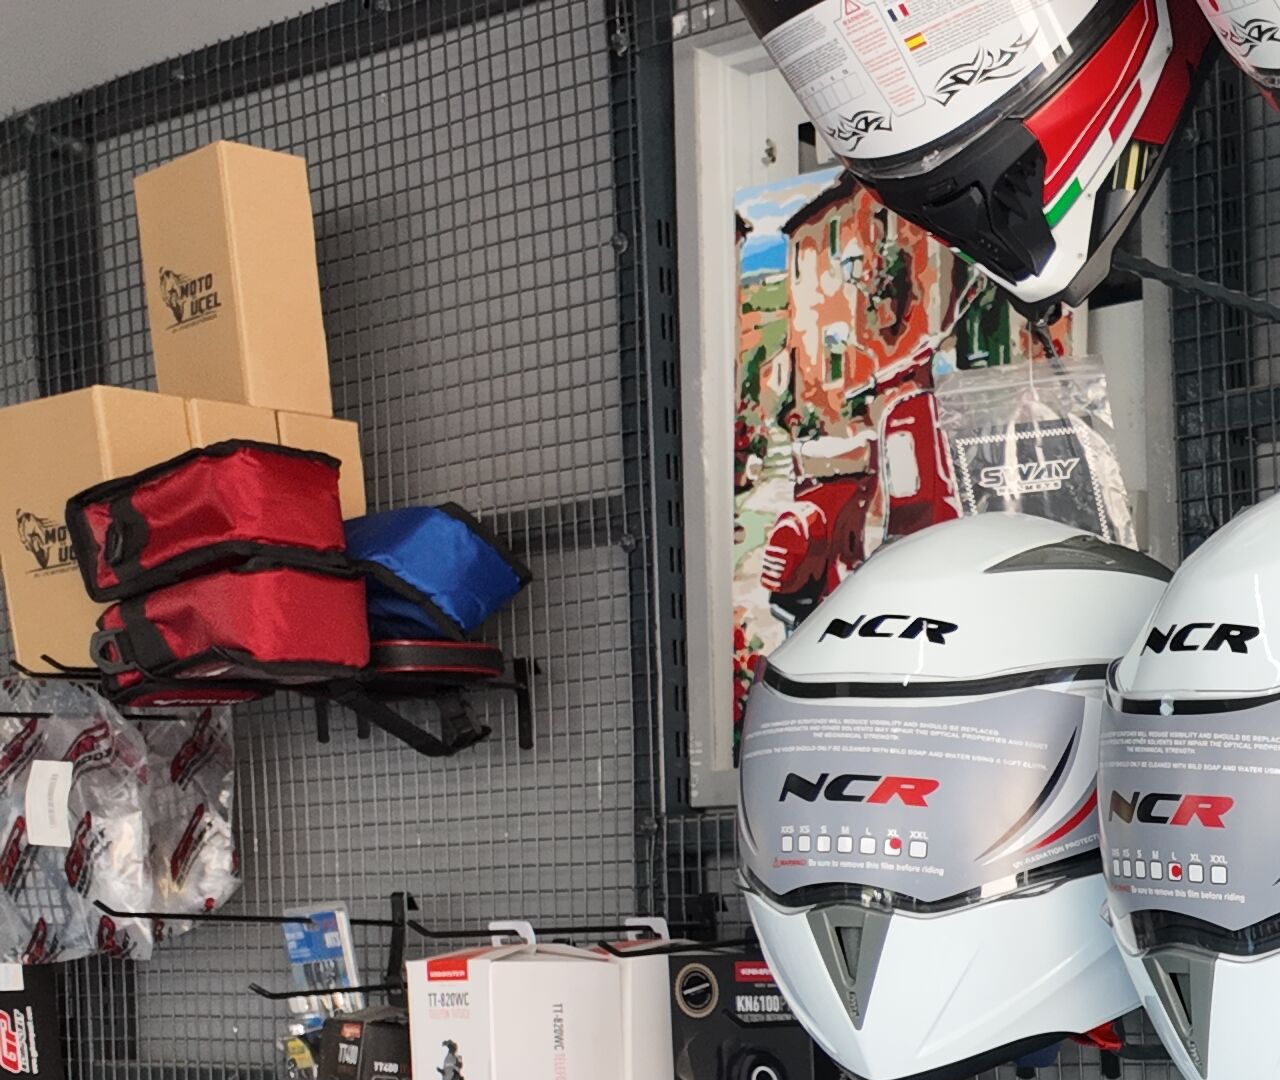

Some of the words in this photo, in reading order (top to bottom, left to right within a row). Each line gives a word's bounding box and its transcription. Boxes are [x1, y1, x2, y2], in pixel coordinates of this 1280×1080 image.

[179, 273, 213, 298] MOTO
[191, 292, 221, 316] UCEL
[979, 458, 1080, 488] SWAY
[45, 526, 66, 544] MO
[818, 614, 958, 645] NCR
[1140, 622, 1260, 655] NCR
[779, 773, 940, 807] NCR
[1108, 790, 1234, 828] NCR
[888, 829, 899, 837] XL
[910, 831, 928, 839] XXL
[428, 992, 470, 1007] TT-820WC
[553, 1004, 564, 1050] TT-820WC
